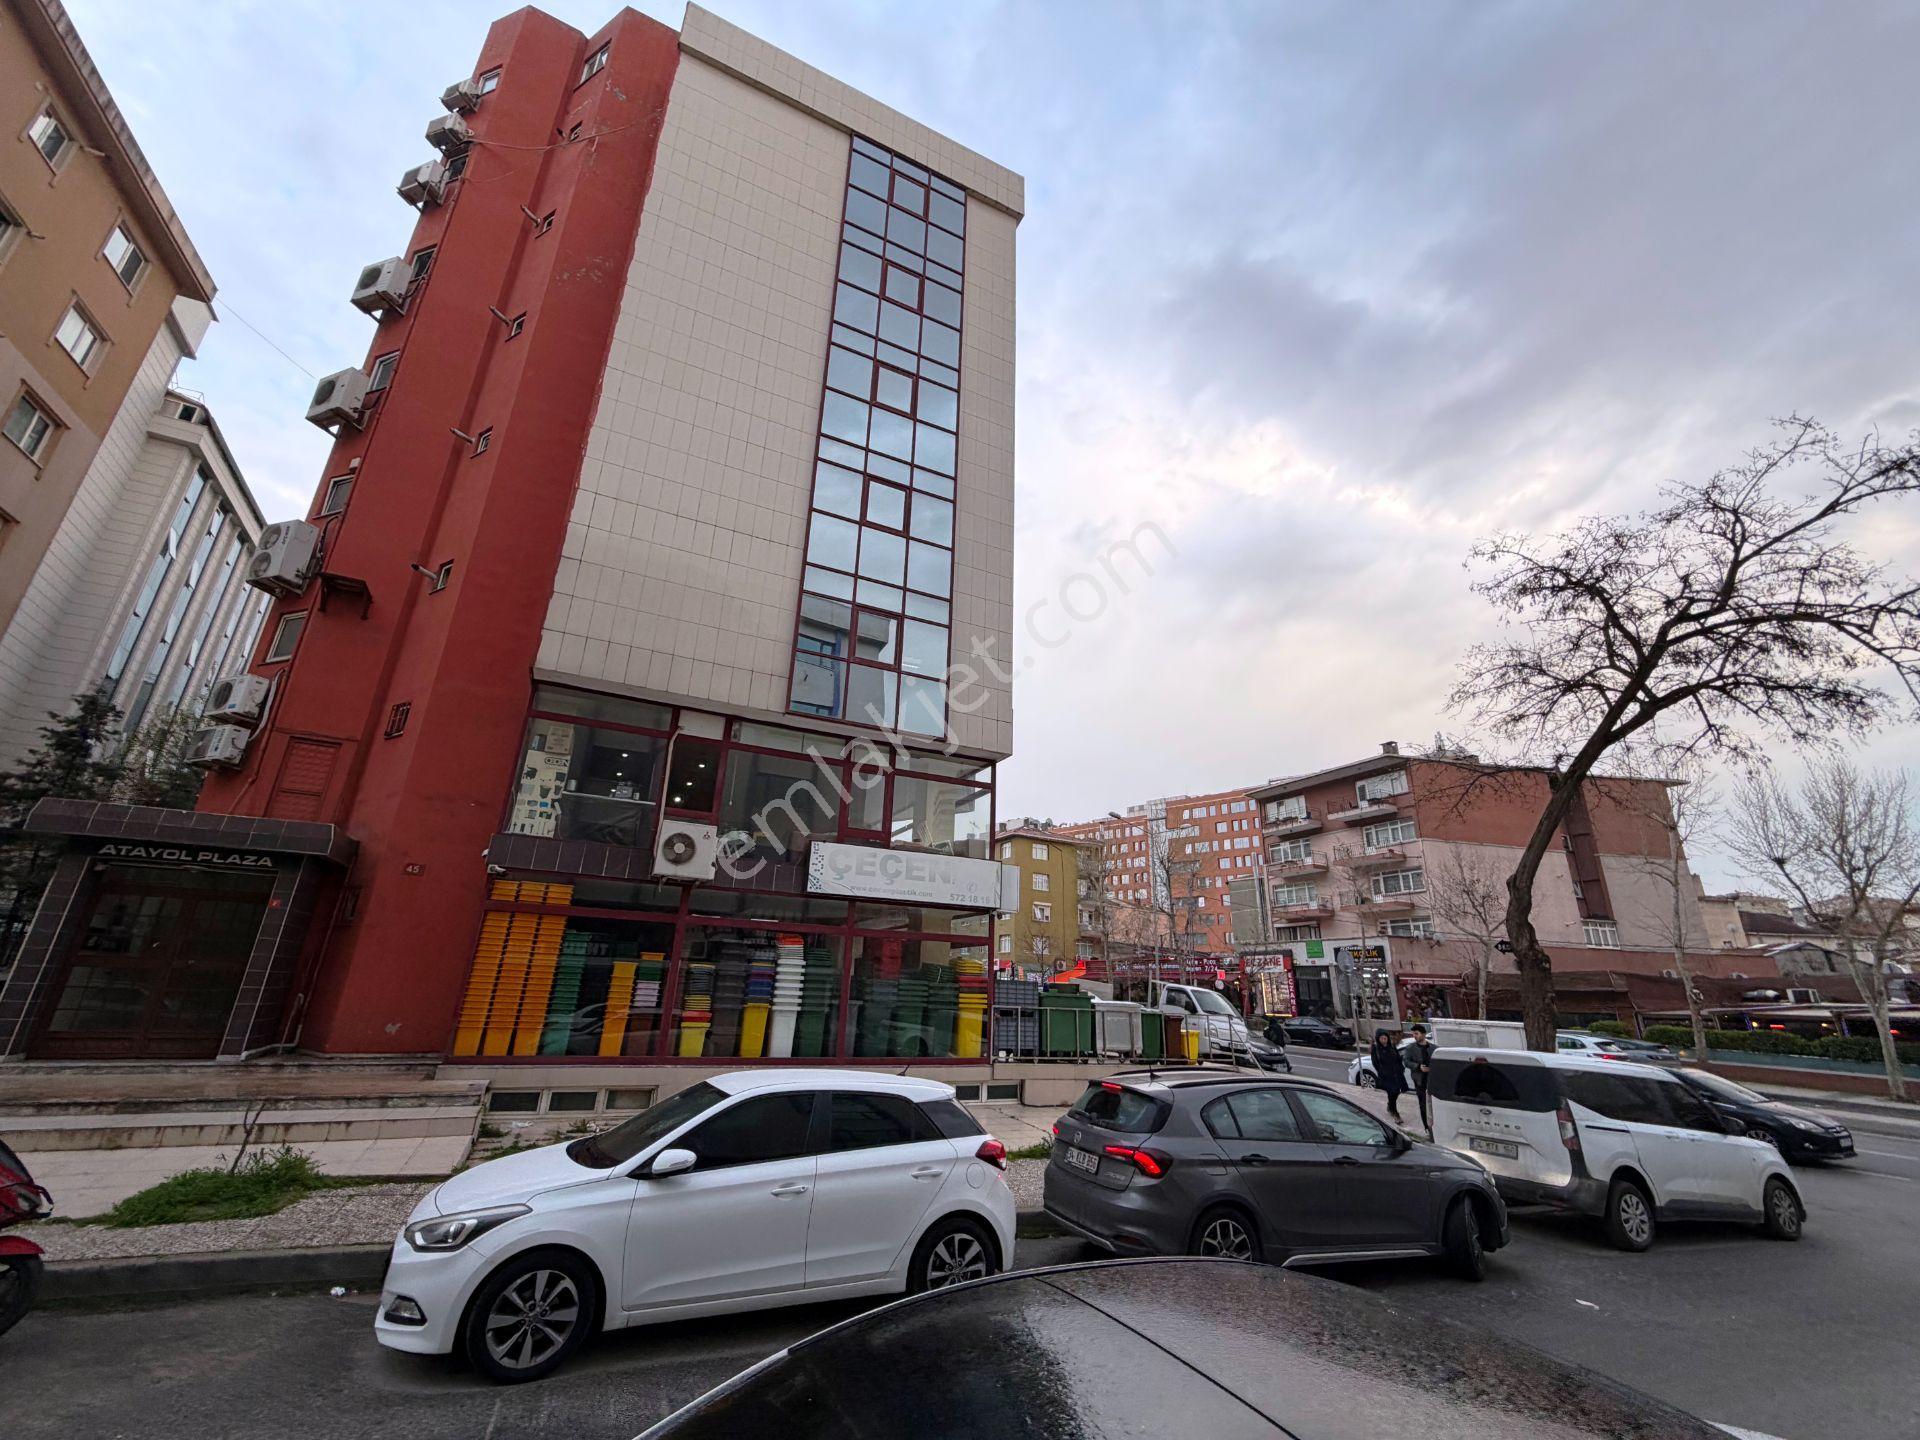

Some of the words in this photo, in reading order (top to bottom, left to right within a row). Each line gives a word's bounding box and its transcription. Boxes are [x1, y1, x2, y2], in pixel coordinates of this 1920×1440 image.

[99, 844, 192, 860] ATAYOL
[197, 852, 272, 866] PLAZA
[406, 865, 420, 874] 45
[828, 848, 952, 886] ÇEÇEN
[1246, 955, 1282, 967] ECZANE
[1288, 972, 1297, 1012] ECZANE
[1459, 1117, 1521, 1130] TOURNEO
